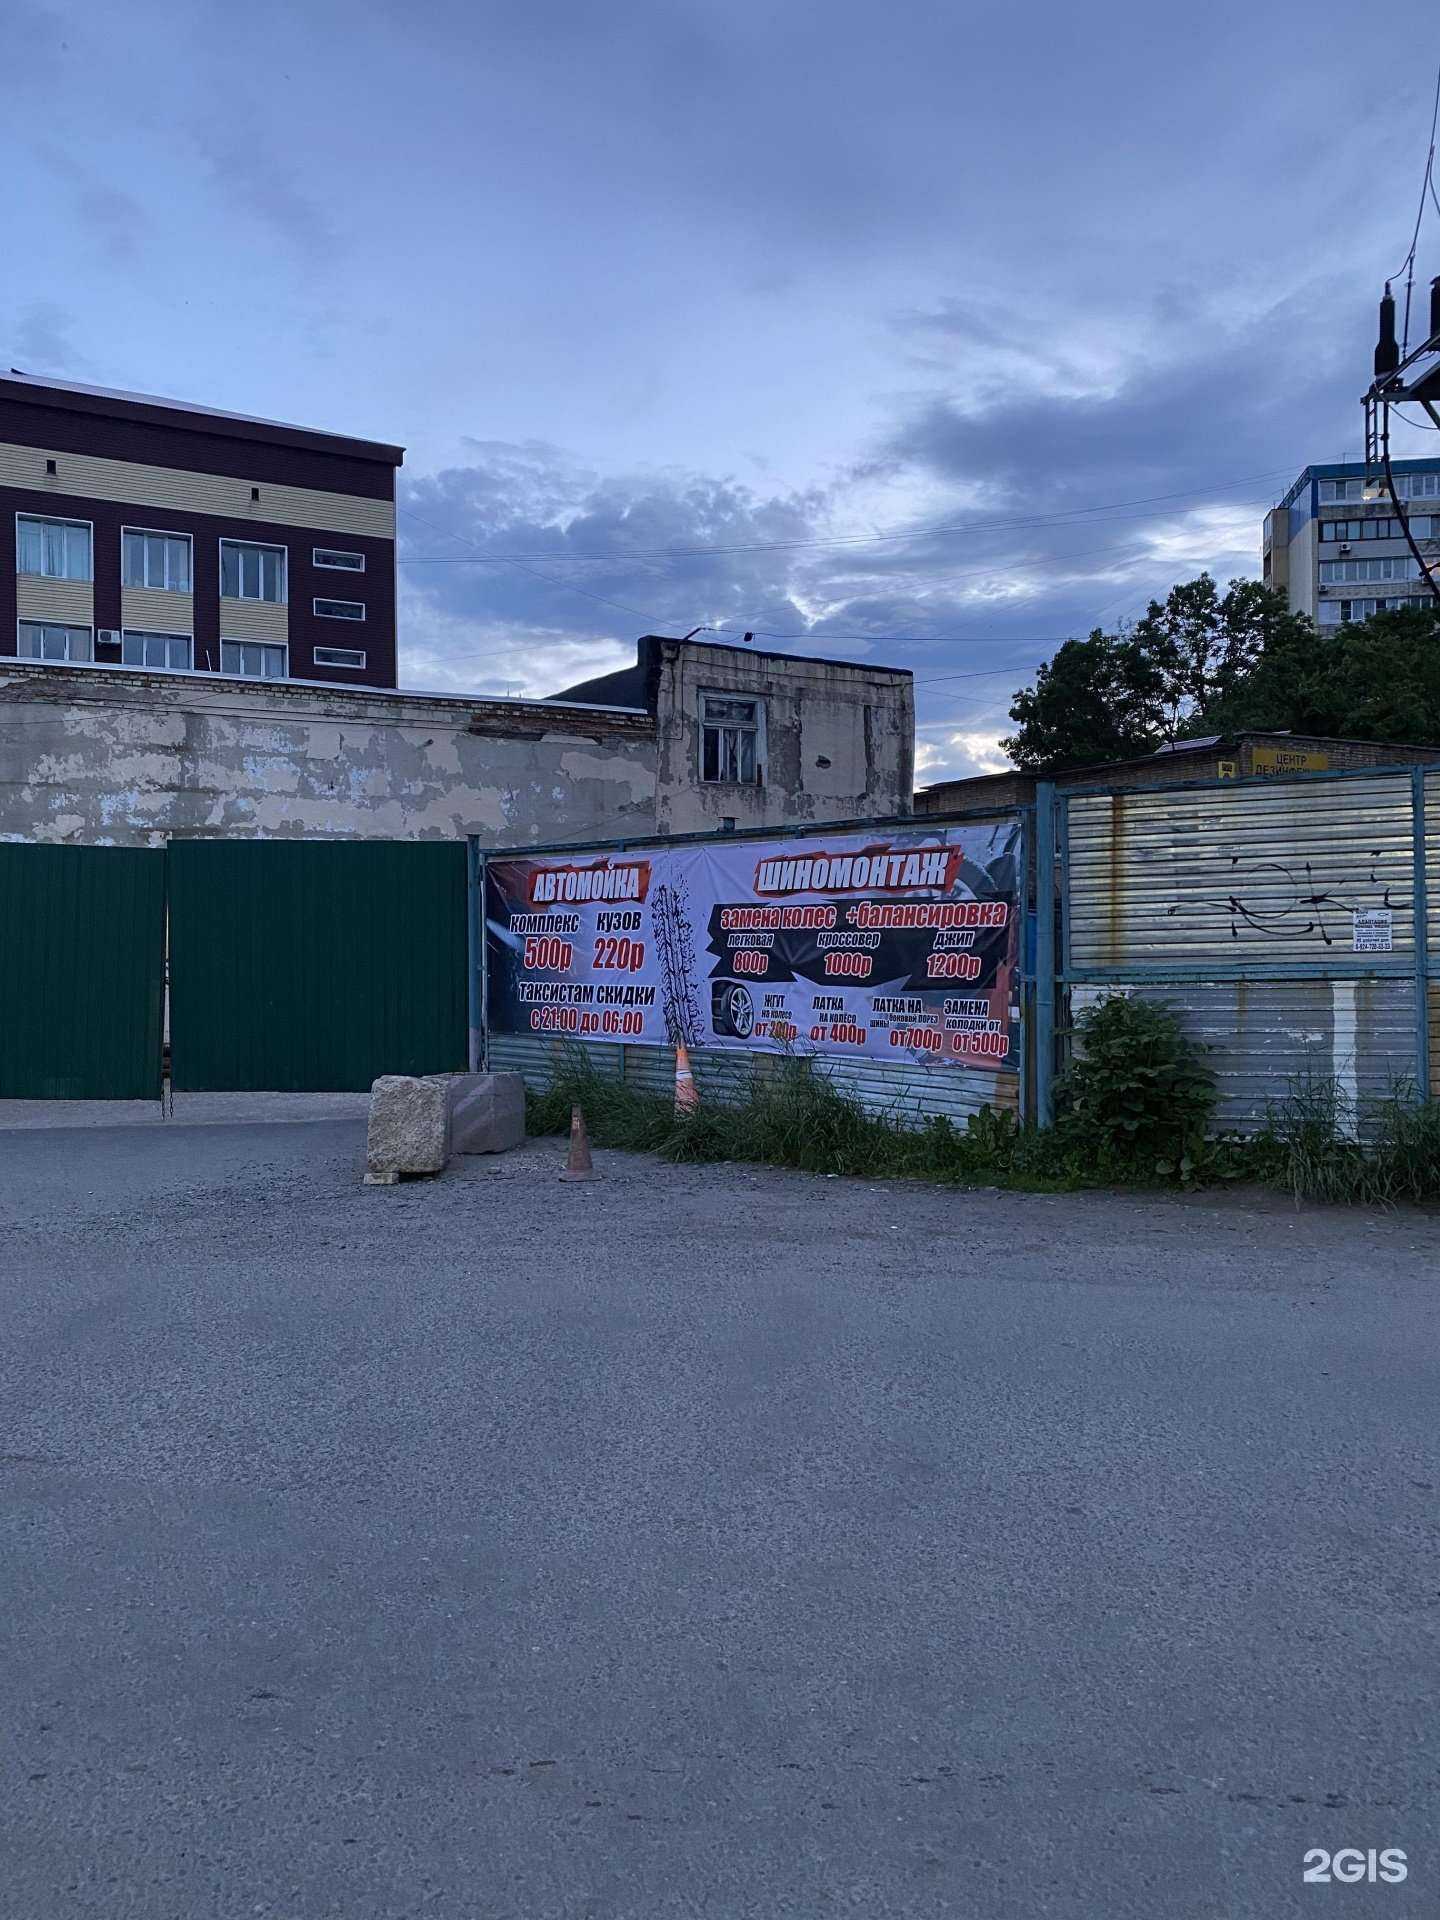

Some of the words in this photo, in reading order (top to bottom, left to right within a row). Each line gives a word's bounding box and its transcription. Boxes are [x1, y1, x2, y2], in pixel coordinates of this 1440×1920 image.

[1276, 752, 1308, 766] ЦЕНТР
[533, 862, 640, 902] АВТОМОЙКА
[758, 852, 949, 891] ШИНОМОНТАЖ
[510, 915, 580, 934] комплекс
[597, 912, 642, 933] кузов
[721, 908, 780, 929] замена
[781, 906, 836, 929] колес
[727, 933, 774, 947] легковая
[817, 932, 880, 948] кроссовер
[934, 931, 975, 949] джип
[524, 937, 573, 972] 500р
[592, 937, 645, 974] 220р
[733, 951, 768, 974] 800р
[824, 952, 872, 978] 1000р
[927, 953, 981, 979] 1200р
[519, 982, 594, 1003] таксистам
[597, 985, 656, 1008] скидки
[764, 994, 786, 1008] ЖГУТ
[812, 996, 844, 1010] ЛАТКА
[872, 997, 905, 1013] ЛАТКА
[907, 998, 922, 1013] НА
[944, 999, 989, 1017] ЗАМЕНА
[580, 1012, 599, 1034] до
[602, 1010, 643, 1035] 06:00
[829, 1023, 867, 1046] 400р
[970, 1031, 1009, 1057] 500р
